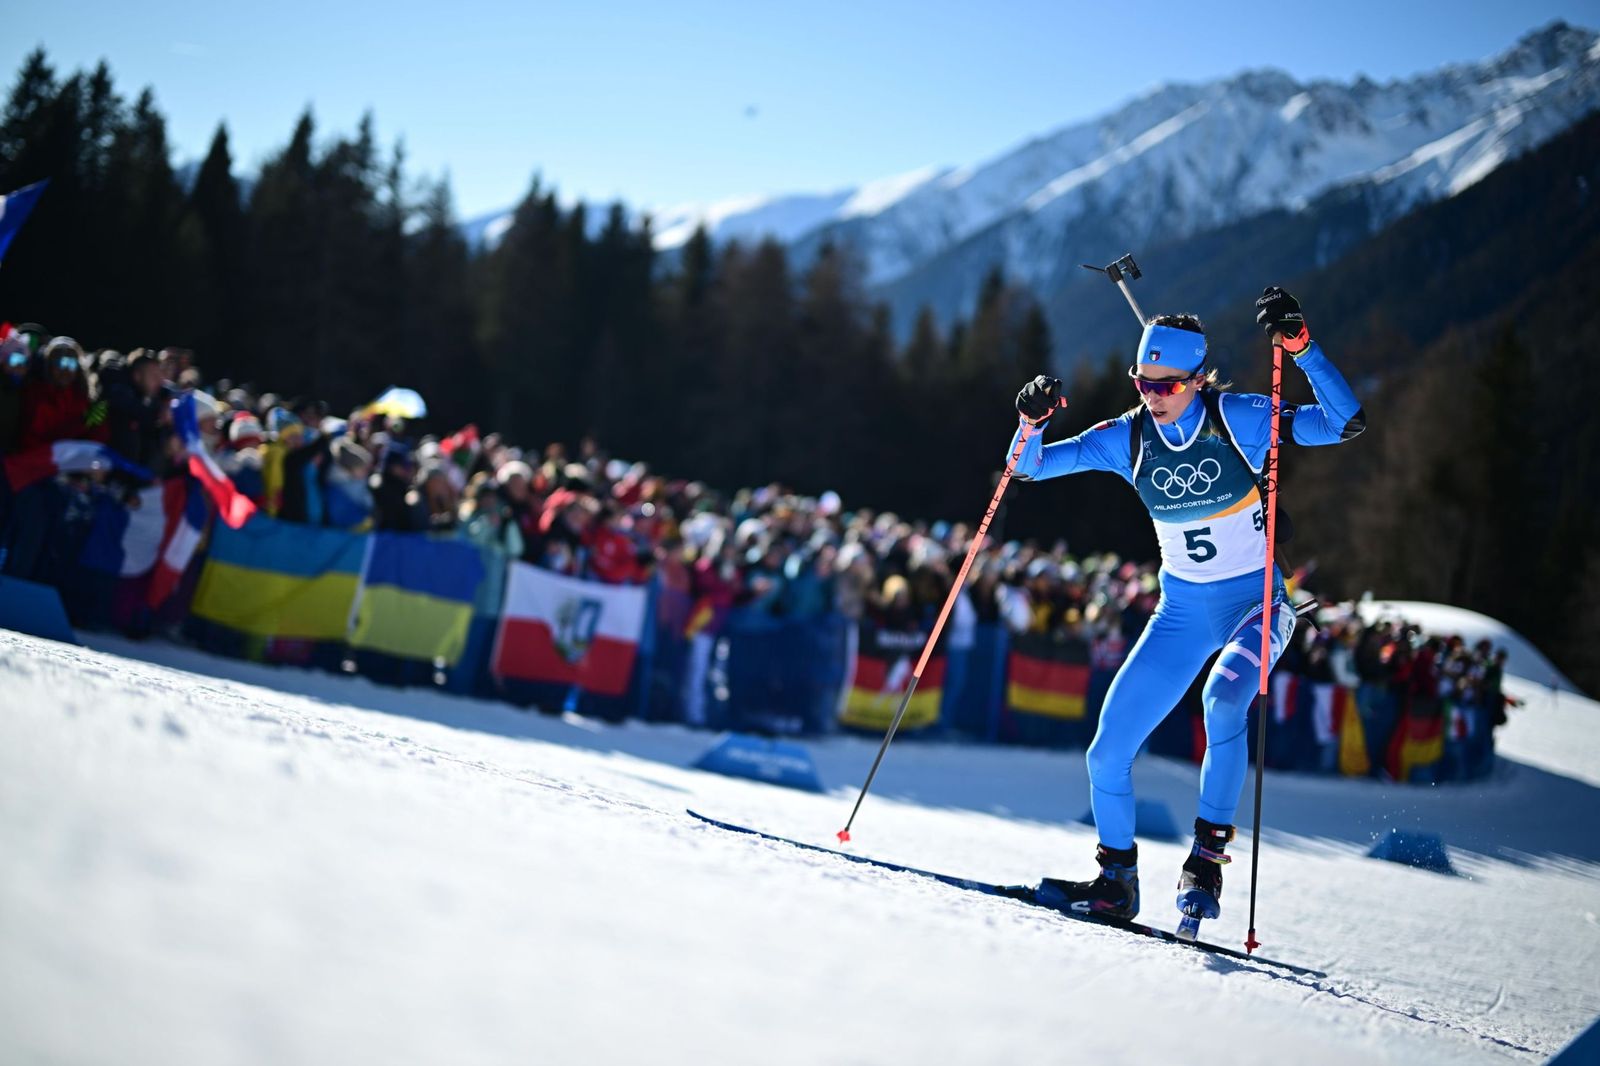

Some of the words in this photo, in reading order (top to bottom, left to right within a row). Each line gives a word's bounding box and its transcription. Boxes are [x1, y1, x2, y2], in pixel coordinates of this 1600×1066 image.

[1153, 503, 1182, 511] MILANO
[1182, 498, 1216, 508] CORTINA
[1216, 492, 1233, 503] 2026
[1252, 508, 1264, 532] 5
[1183, 526, 1218, 564] 5
